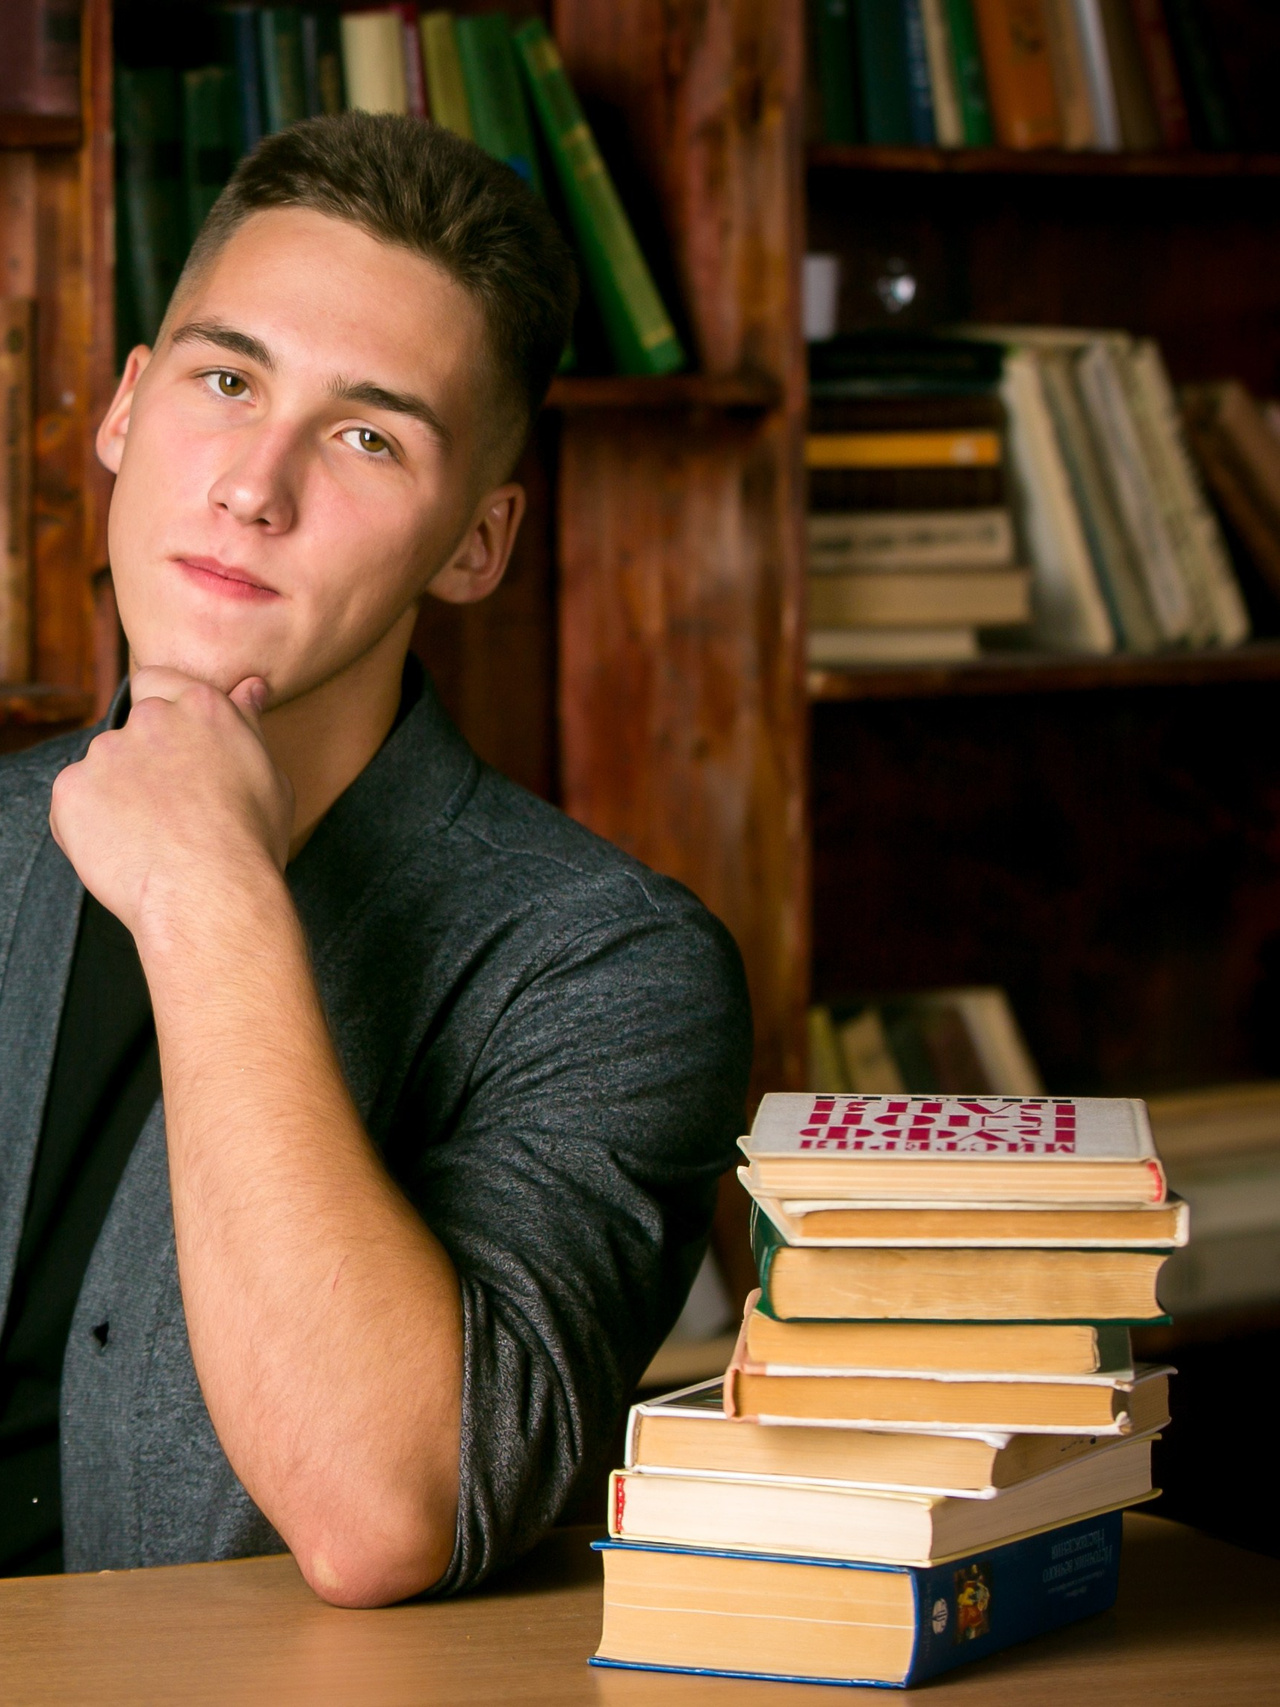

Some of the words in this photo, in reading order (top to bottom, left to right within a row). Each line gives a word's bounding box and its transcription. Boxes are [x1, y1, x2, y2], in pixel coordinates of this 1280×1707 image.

[812, 1101, 1076, 1115] БАНЯ
[808, 1113, 1076, 1127] КЛОП
[799, 1126, 1076, 1142] БУФФ
[799, 1140, 1076, 1154] МИСТЕРИЯ
